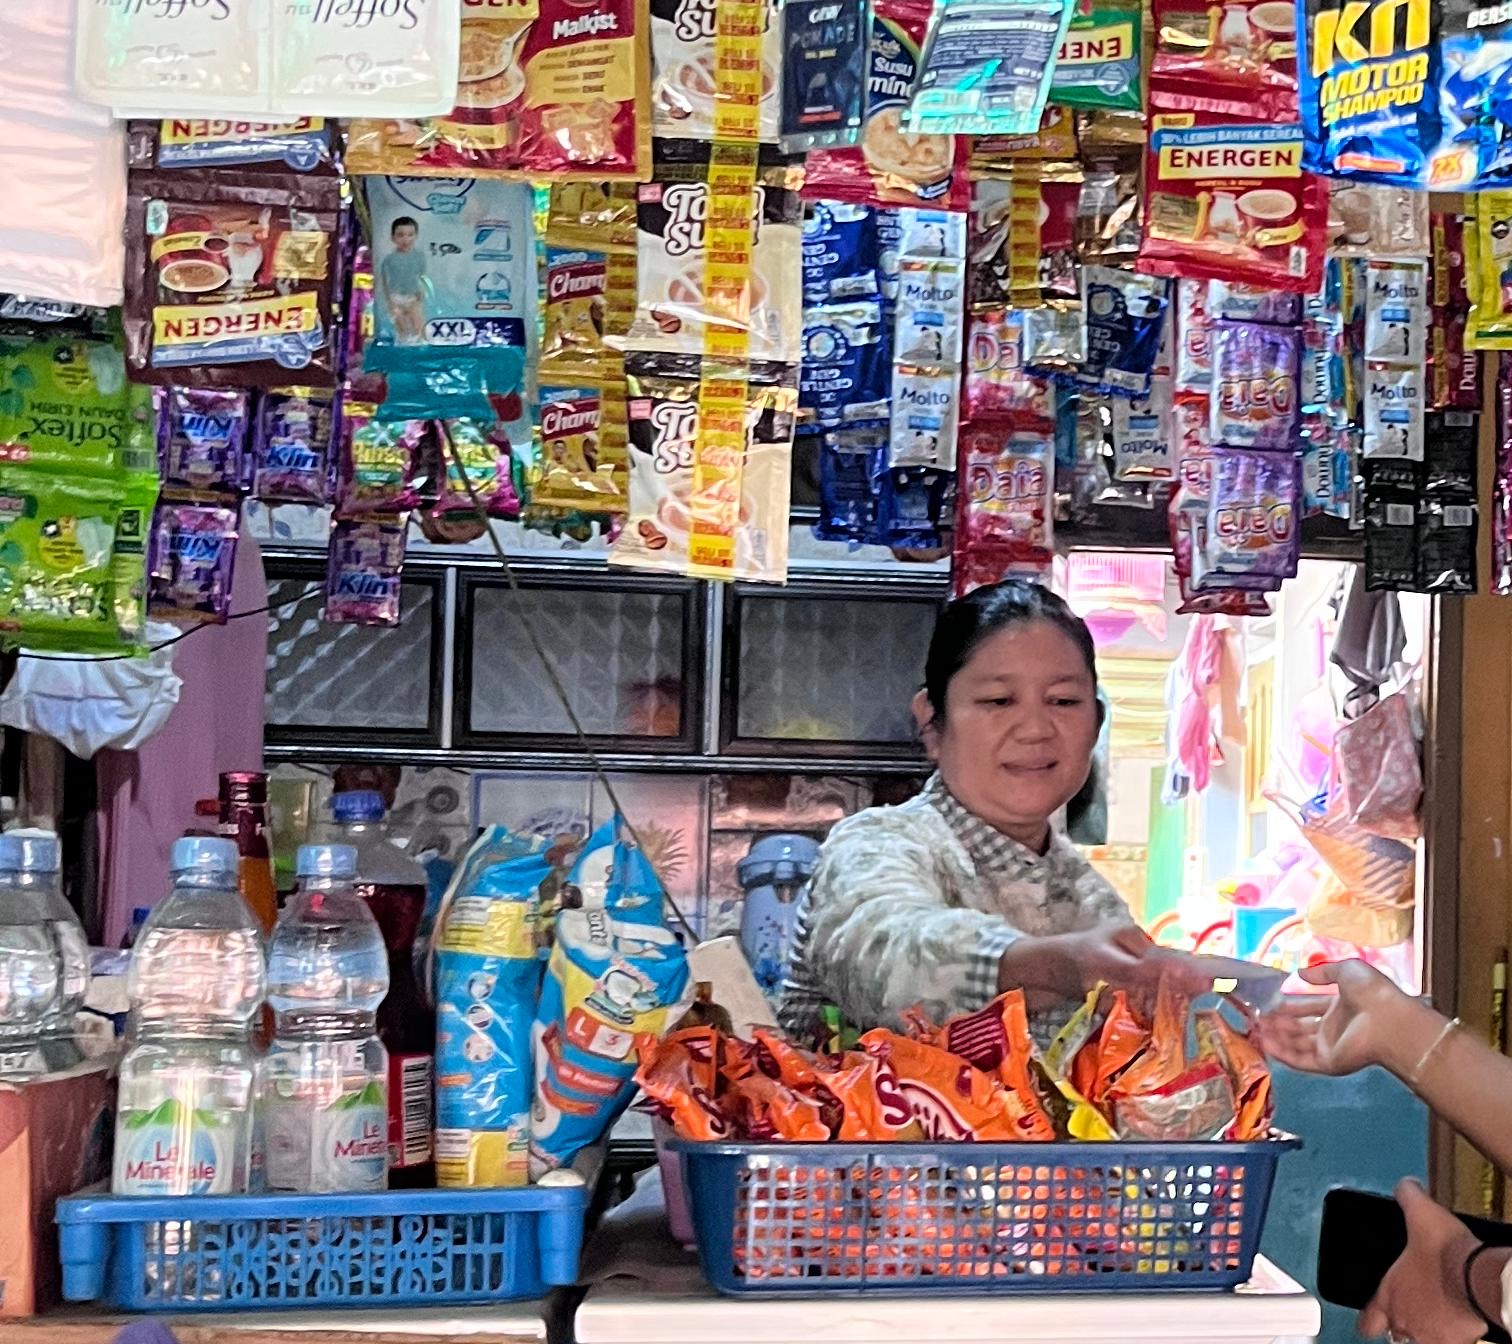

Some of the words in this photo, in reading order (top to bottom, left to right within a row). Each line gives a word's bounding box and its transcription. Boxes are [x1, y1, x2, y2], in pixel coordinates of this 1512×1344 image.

[553, 11, 618, 39] Malkist
[874, 57, 913, 80] Susu
[1320, 53, 1428, 98] MOTOR
[1321, 82, 1423, 125] SHAMPOO
[1169, 149, 1293, 169] ENERGEN
[162, 305, 304, 339] ENERGEN
[431, 320, 468, 339] XXL
[901, 388, 951, 407] Molto
[1370, 382, 1417, 400] Molto
[37, 418, 122, 448] Softex
[361, 1120, 380, 1139] Le
